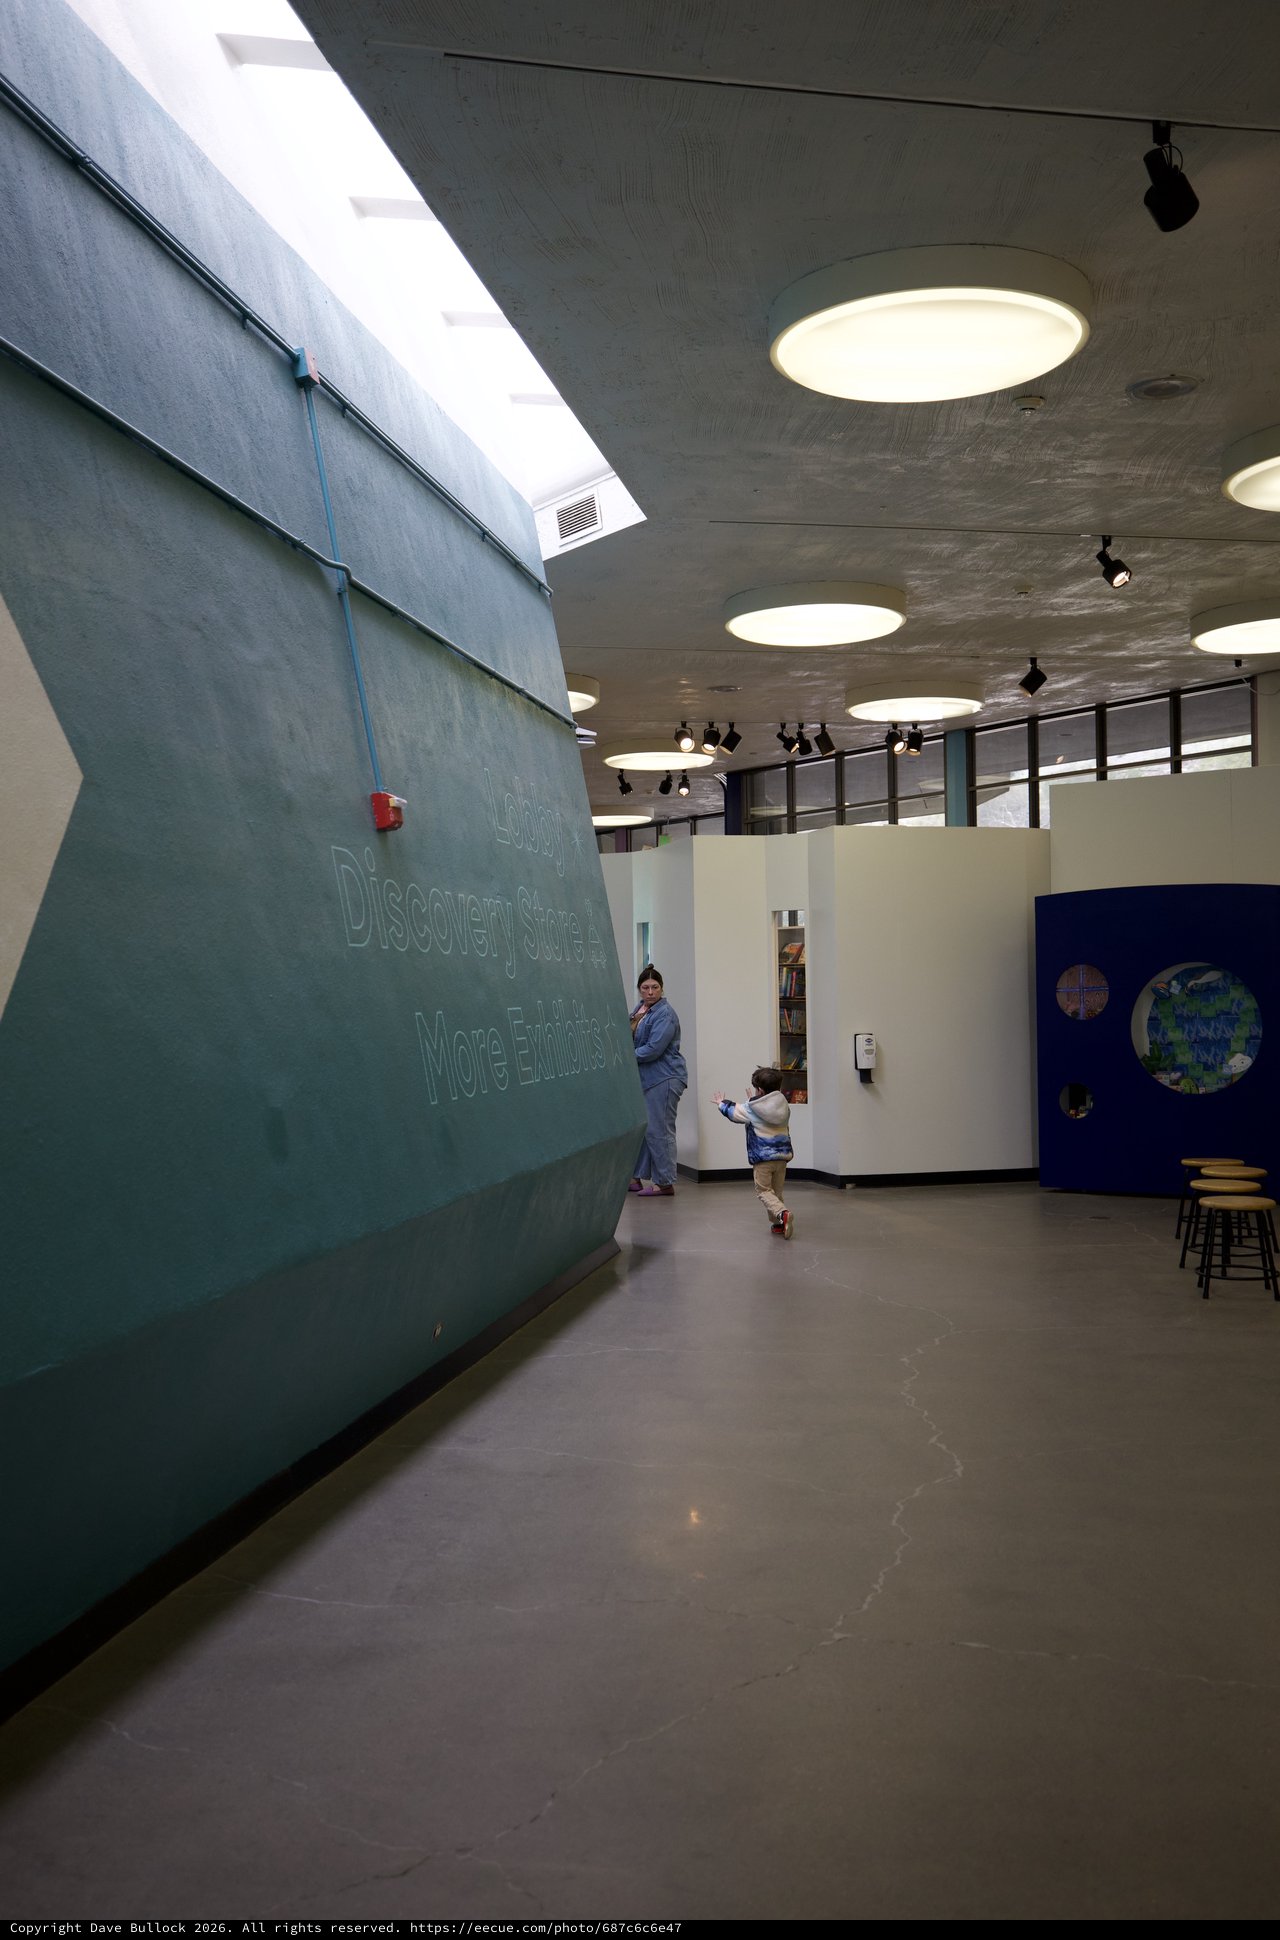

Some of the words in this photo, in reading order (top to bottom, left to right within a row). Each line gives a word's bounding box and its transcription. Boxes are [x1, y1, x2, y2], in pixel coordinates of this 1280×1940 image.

[484, 768, 565, 877] Lobby
[331, 845, 516, 979] Discovery
[517, 886, 585, 963] Store
[415, 1010, 509, 1105] More
[507, 999, 606, 1086] Exhibits
